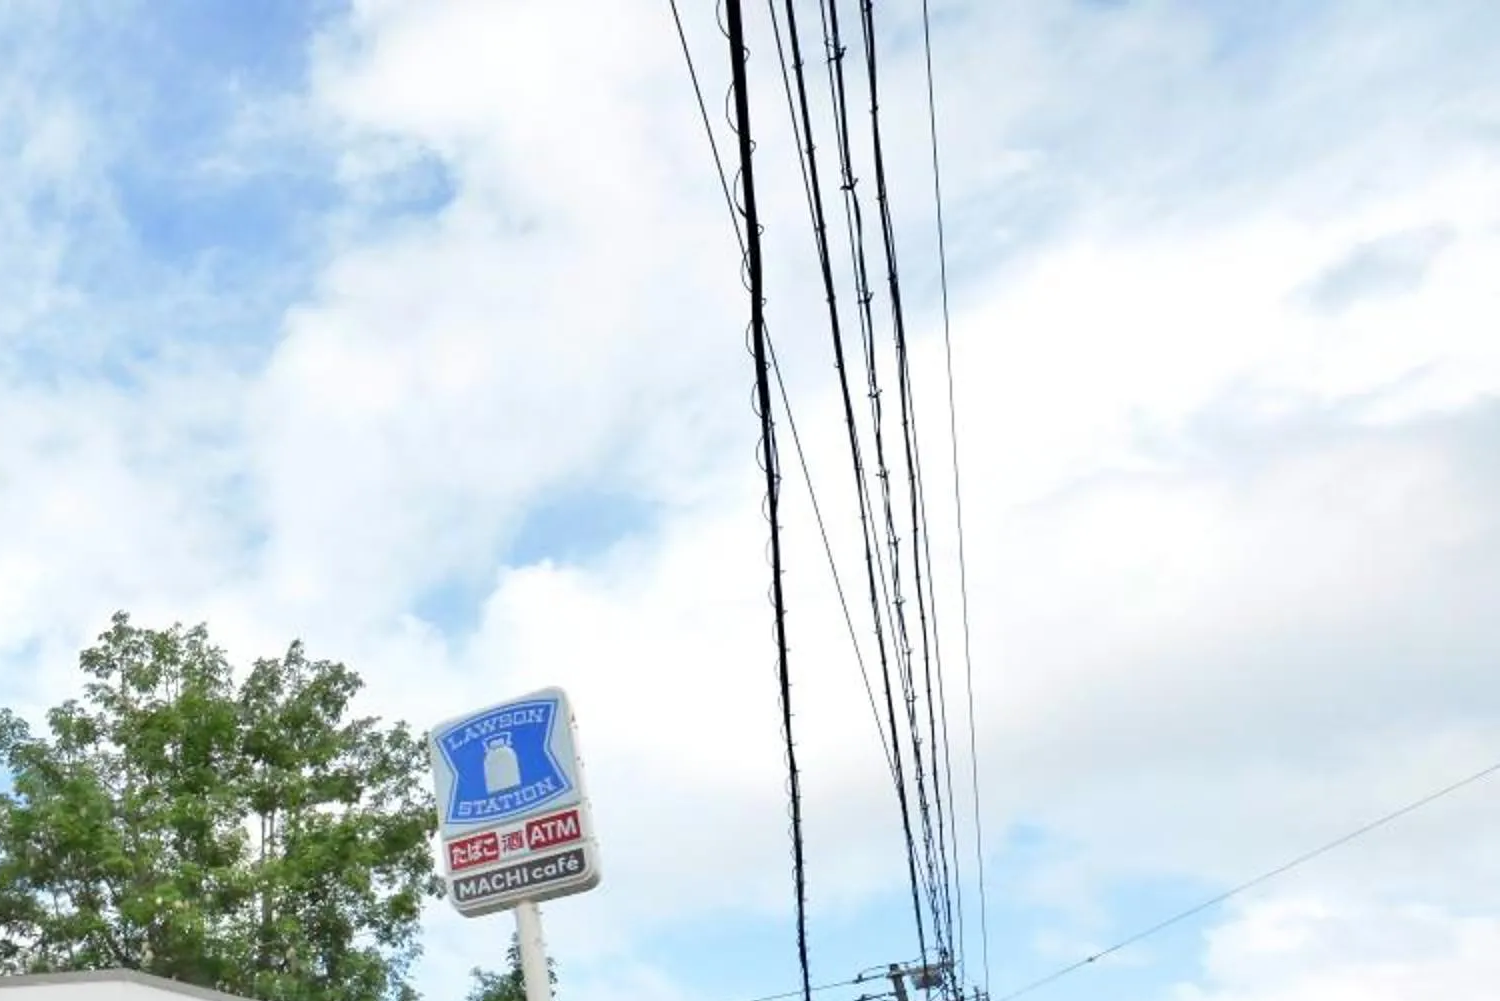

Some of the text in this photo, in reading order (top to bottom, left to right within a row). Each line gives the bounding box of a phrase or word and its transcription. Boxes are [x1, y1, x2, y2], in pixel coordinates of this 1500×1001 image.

[448, 707, 546, 751] LAWSON
[457, 776, 557, 817] STATION
[451, 836, 498, 866] たばこ
[530, 814, 578, 846] ATM
[458, 867, 530, 899] MACHI
